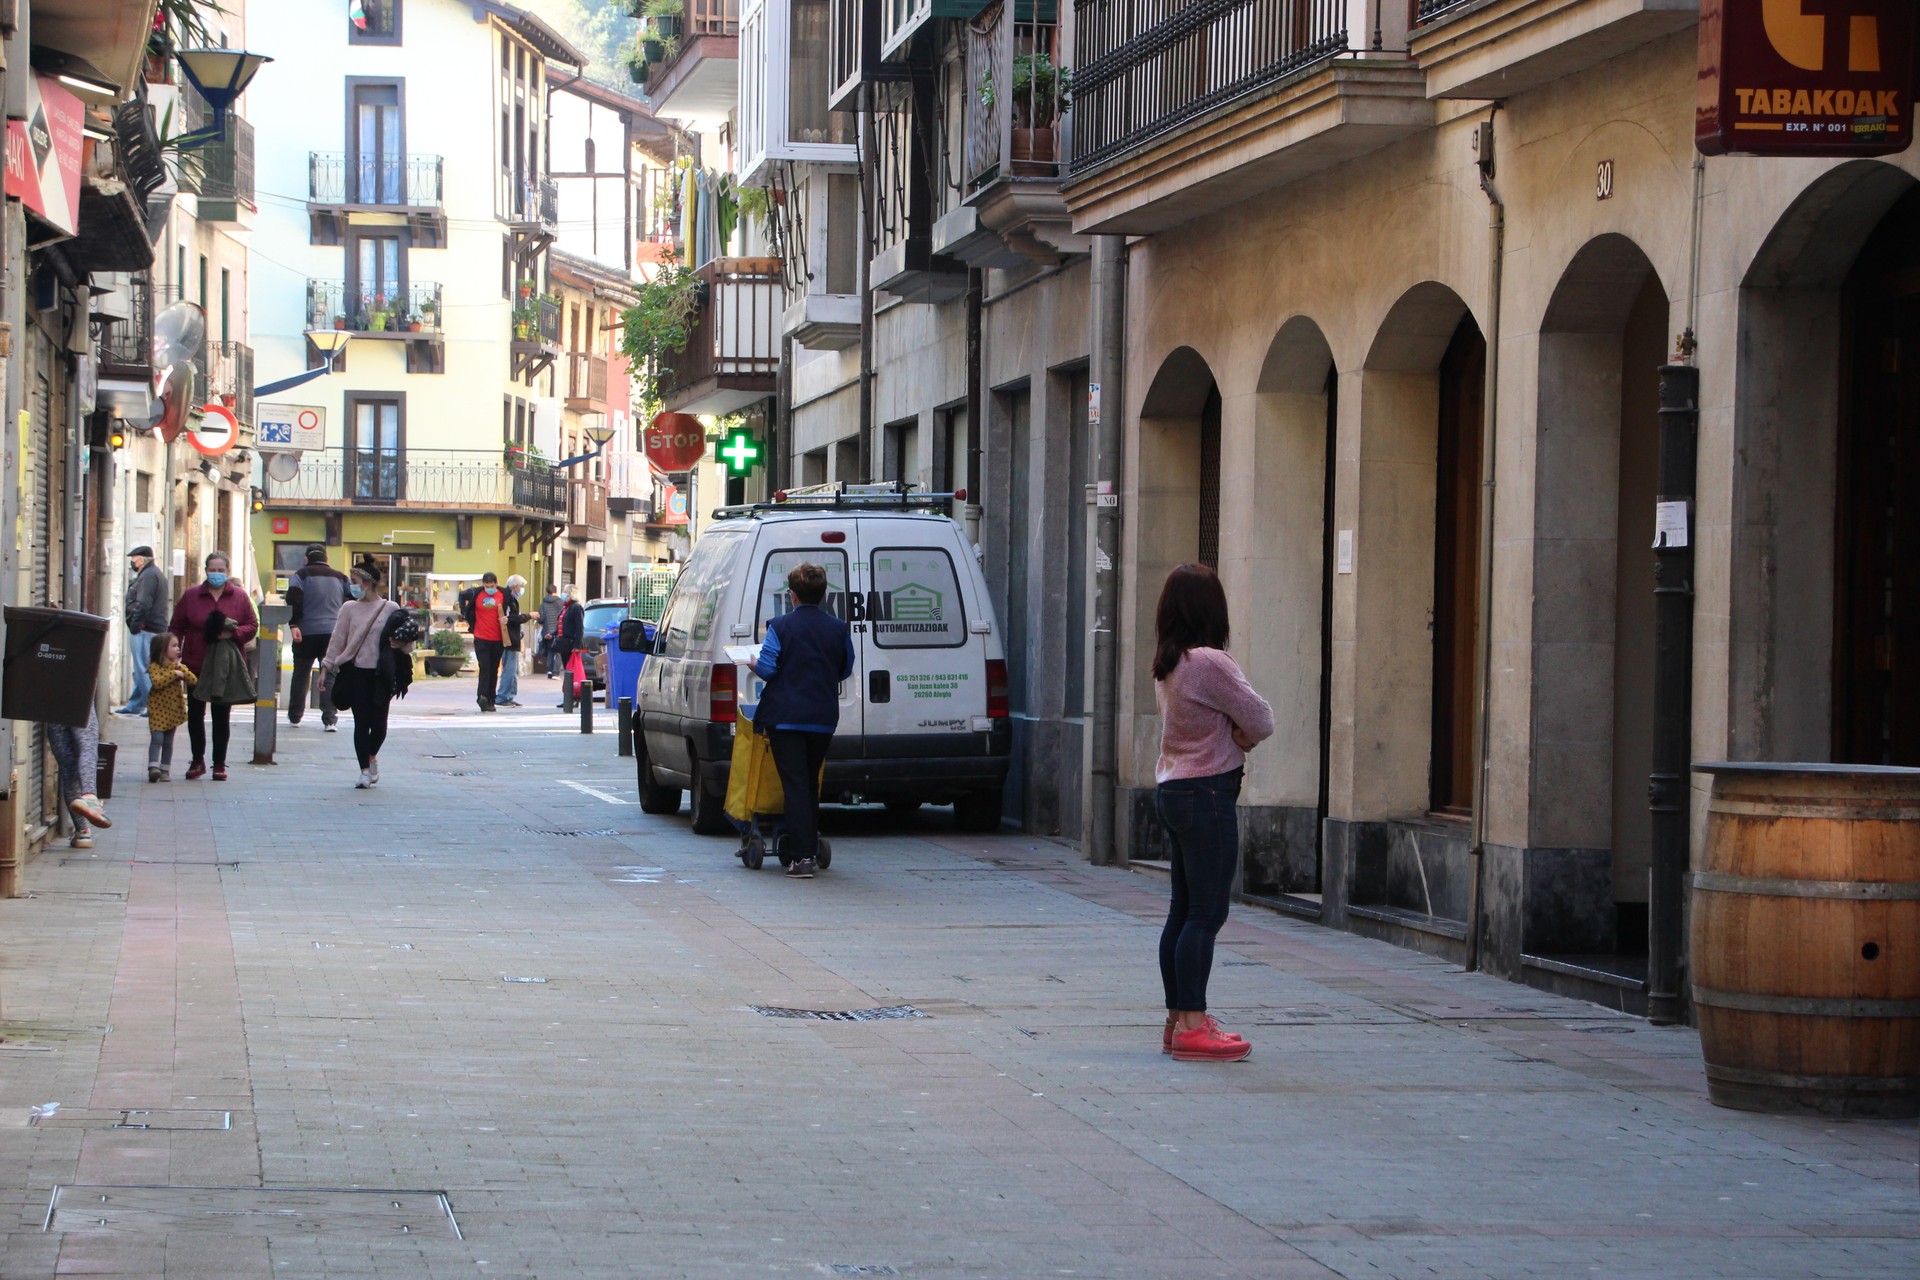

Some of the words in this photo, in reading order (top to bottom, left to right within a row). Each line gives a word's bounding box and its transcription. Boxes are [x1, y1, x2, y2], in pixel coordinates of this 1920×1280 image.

[1735, 88, 1899, 116] TABAKOAK
[1785, 122, 1809, 132] EXP.
[1827, 123, 1847, 132] 001
[1597, 161, 1611, 197] 30
[650, 433, 700, 449] STOP
[853, 624, 868, 634] ETA
[875, 623, 949, 633] AUTOMATIZAZIOAK
[933, 682, 950, 690] kalea
[918, 719, 967, 727] JUMPY
